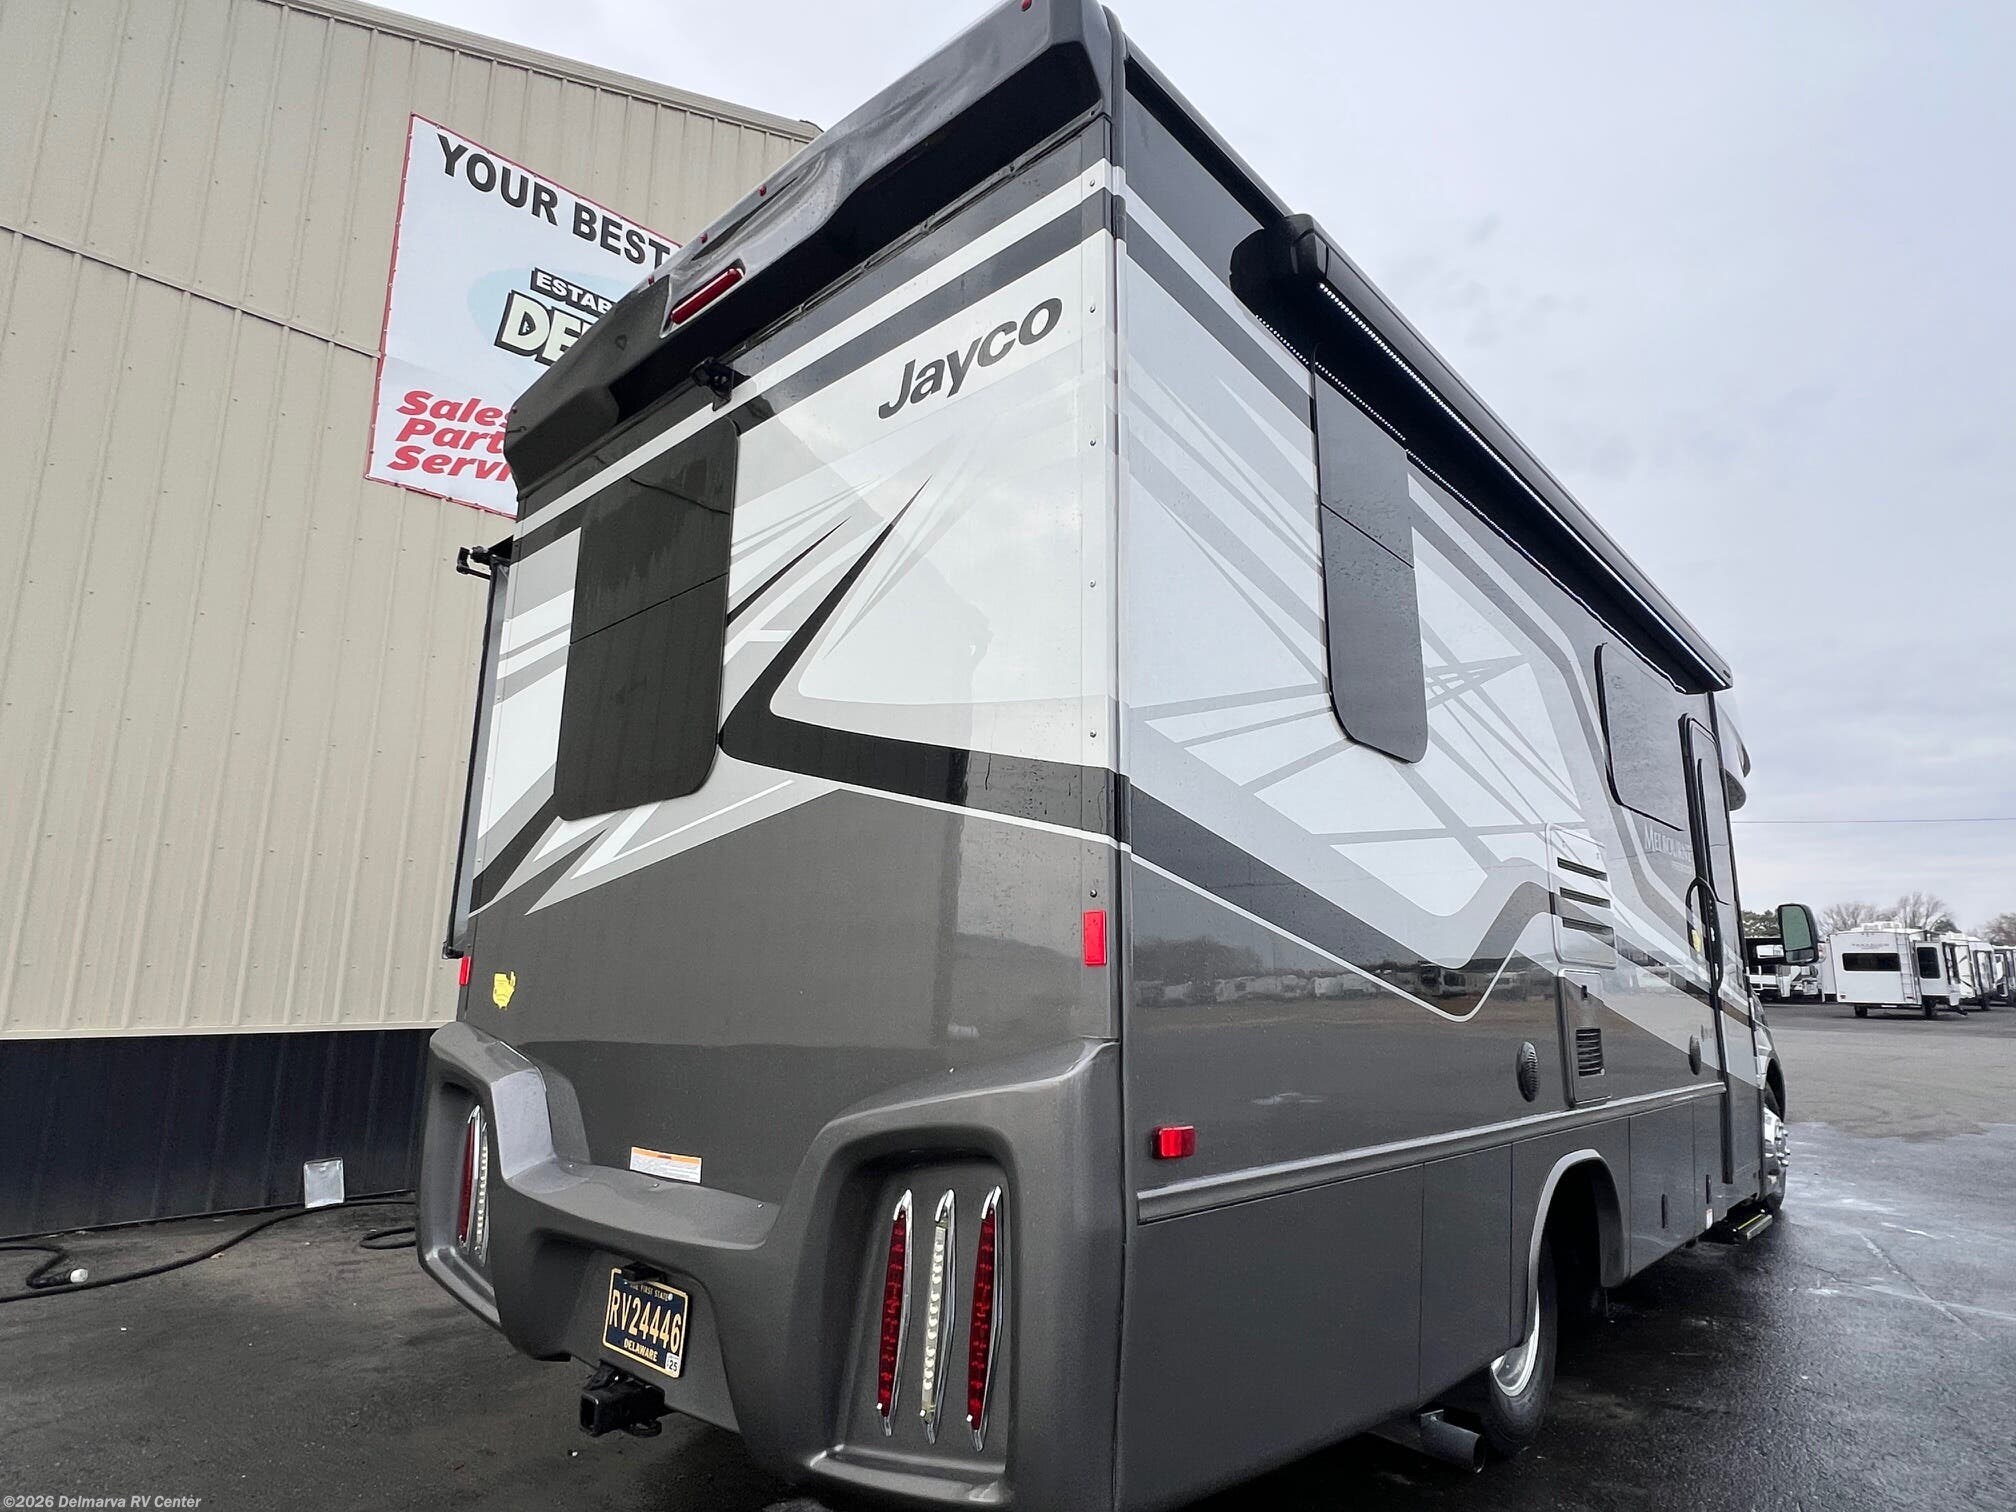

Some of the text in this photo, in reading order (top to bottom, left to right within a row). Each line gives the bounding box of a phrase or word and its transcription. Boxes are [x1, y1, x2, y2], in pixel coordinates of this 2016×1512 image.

[437, 133, 671, 269] YOUR BEST
[878, 297, 1063, 420] Jayco
[609, 1289, 682, 1354] RV24446
[624, 1338, 659, 1362] DELAWARE
[669, 1359, 678, 1372] 25
